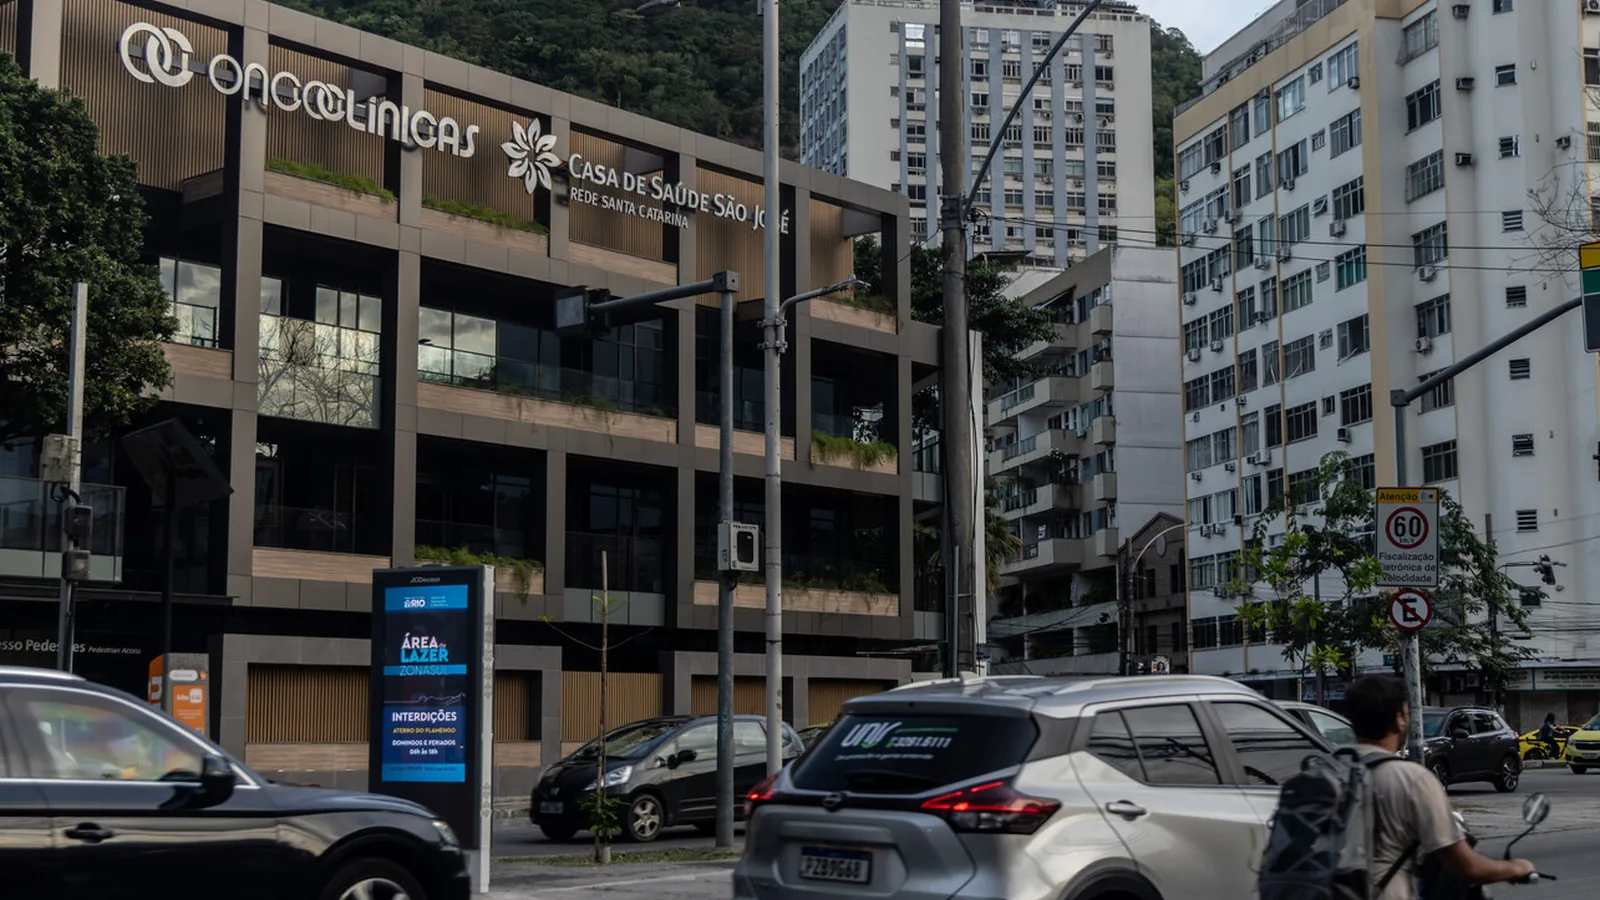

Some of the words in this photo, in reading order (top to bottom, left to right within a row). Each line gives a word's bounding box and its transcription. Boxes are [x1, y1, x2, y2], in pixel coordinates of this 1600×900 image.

[568, 153, 620, 189] CASA
[623, 171, 647, 196] DE
[651, 175, 710, 213] SAÚDE
[714, 193, 748, 222] SÃO
[570, 187, 599, 206] REDE
[601, 195, 637, 216] SANTA
[638, 204, 689, 229] CATARINA
[1379, 492, 1418, 502] Atenção
[1393, 515, 1421, 538] 60
[1379, 552, 1435, 562] Fiscalização
[1424, 563, 1437, 572] de
[1382, 573, 1432, 582] Velocidade
[401, 632, 438, 649] ÁREA
[401, 647, 449, 663] LAZER
[391, 709, 457, 723] INTERDIÇÕES
